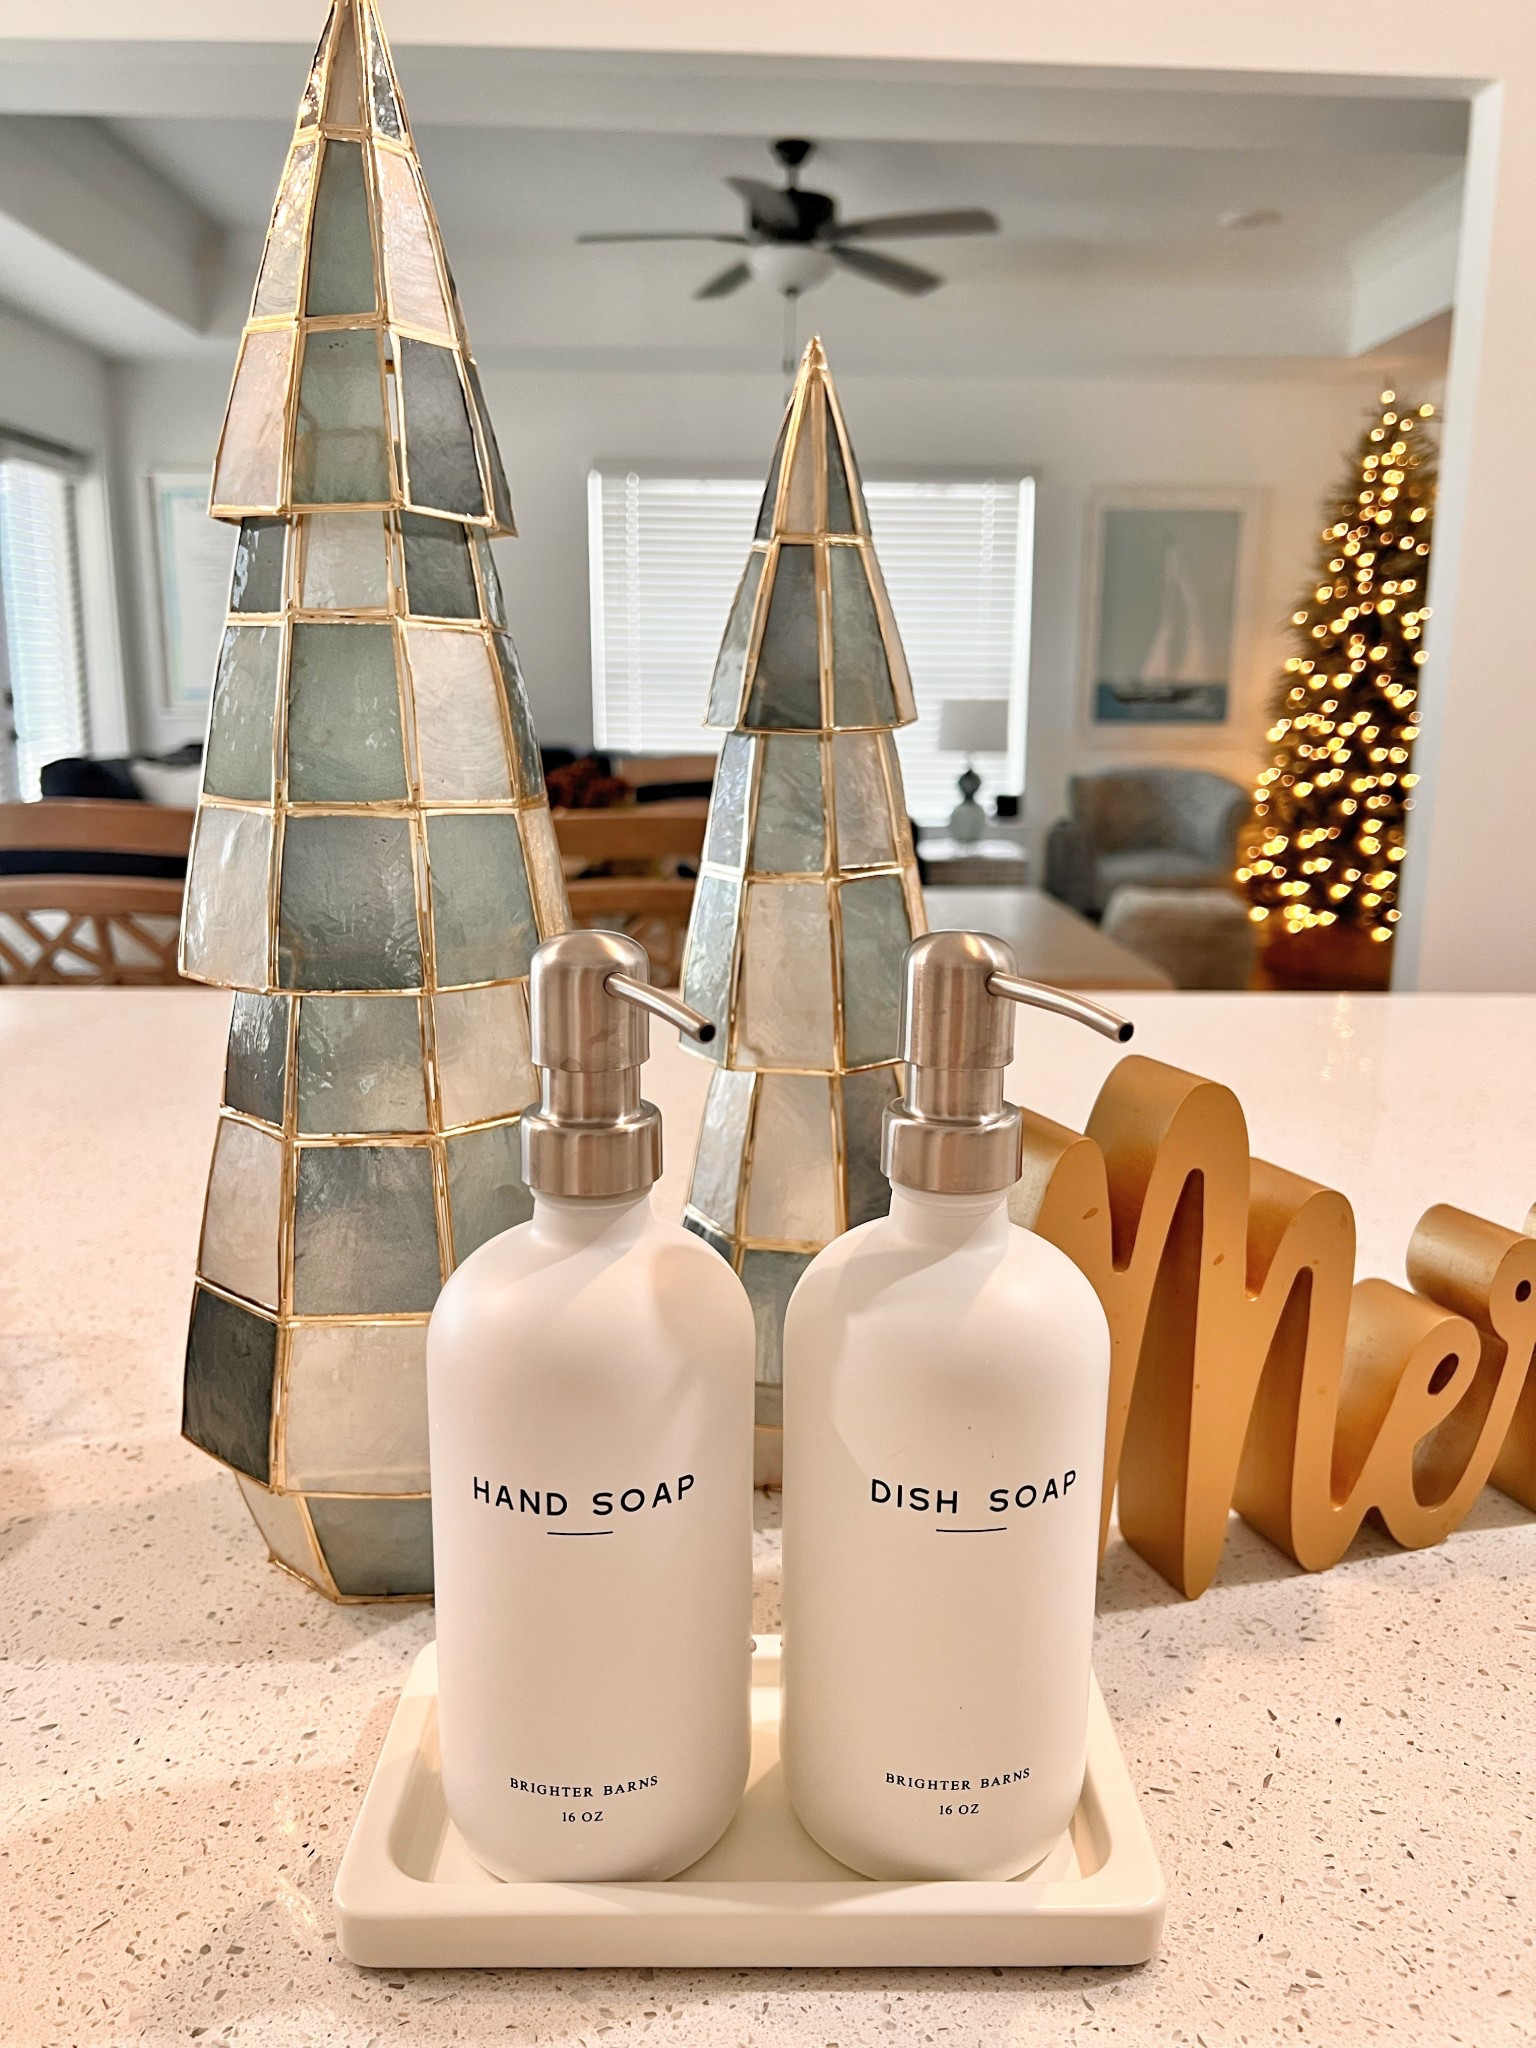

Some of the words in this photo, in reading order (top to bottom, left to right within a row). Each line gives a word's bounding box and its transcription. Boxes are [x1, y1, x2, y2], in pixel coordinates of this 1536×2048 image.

[473, 1475, 568, 1517] HAND
[592, 1474, 695, 1516] SOAP
[871, 1478, 958, 1515] DISH
[988, 1469, 1077, 1513] SOAP
[509, 1777, 594, 1798] BRIGHTER
[603, 1775, 658, 1797] BARNS
[885, 1772, 972, 1791] BRIGHTER
[979, 1767, 1030, 1789] BARNS
[562, 1811, 576, 1823] 16
[581, 1810, 604, 1823] OZ
[939, 1804, 953, 1816] 16
[958, 1803, 980, 1816] OZ
